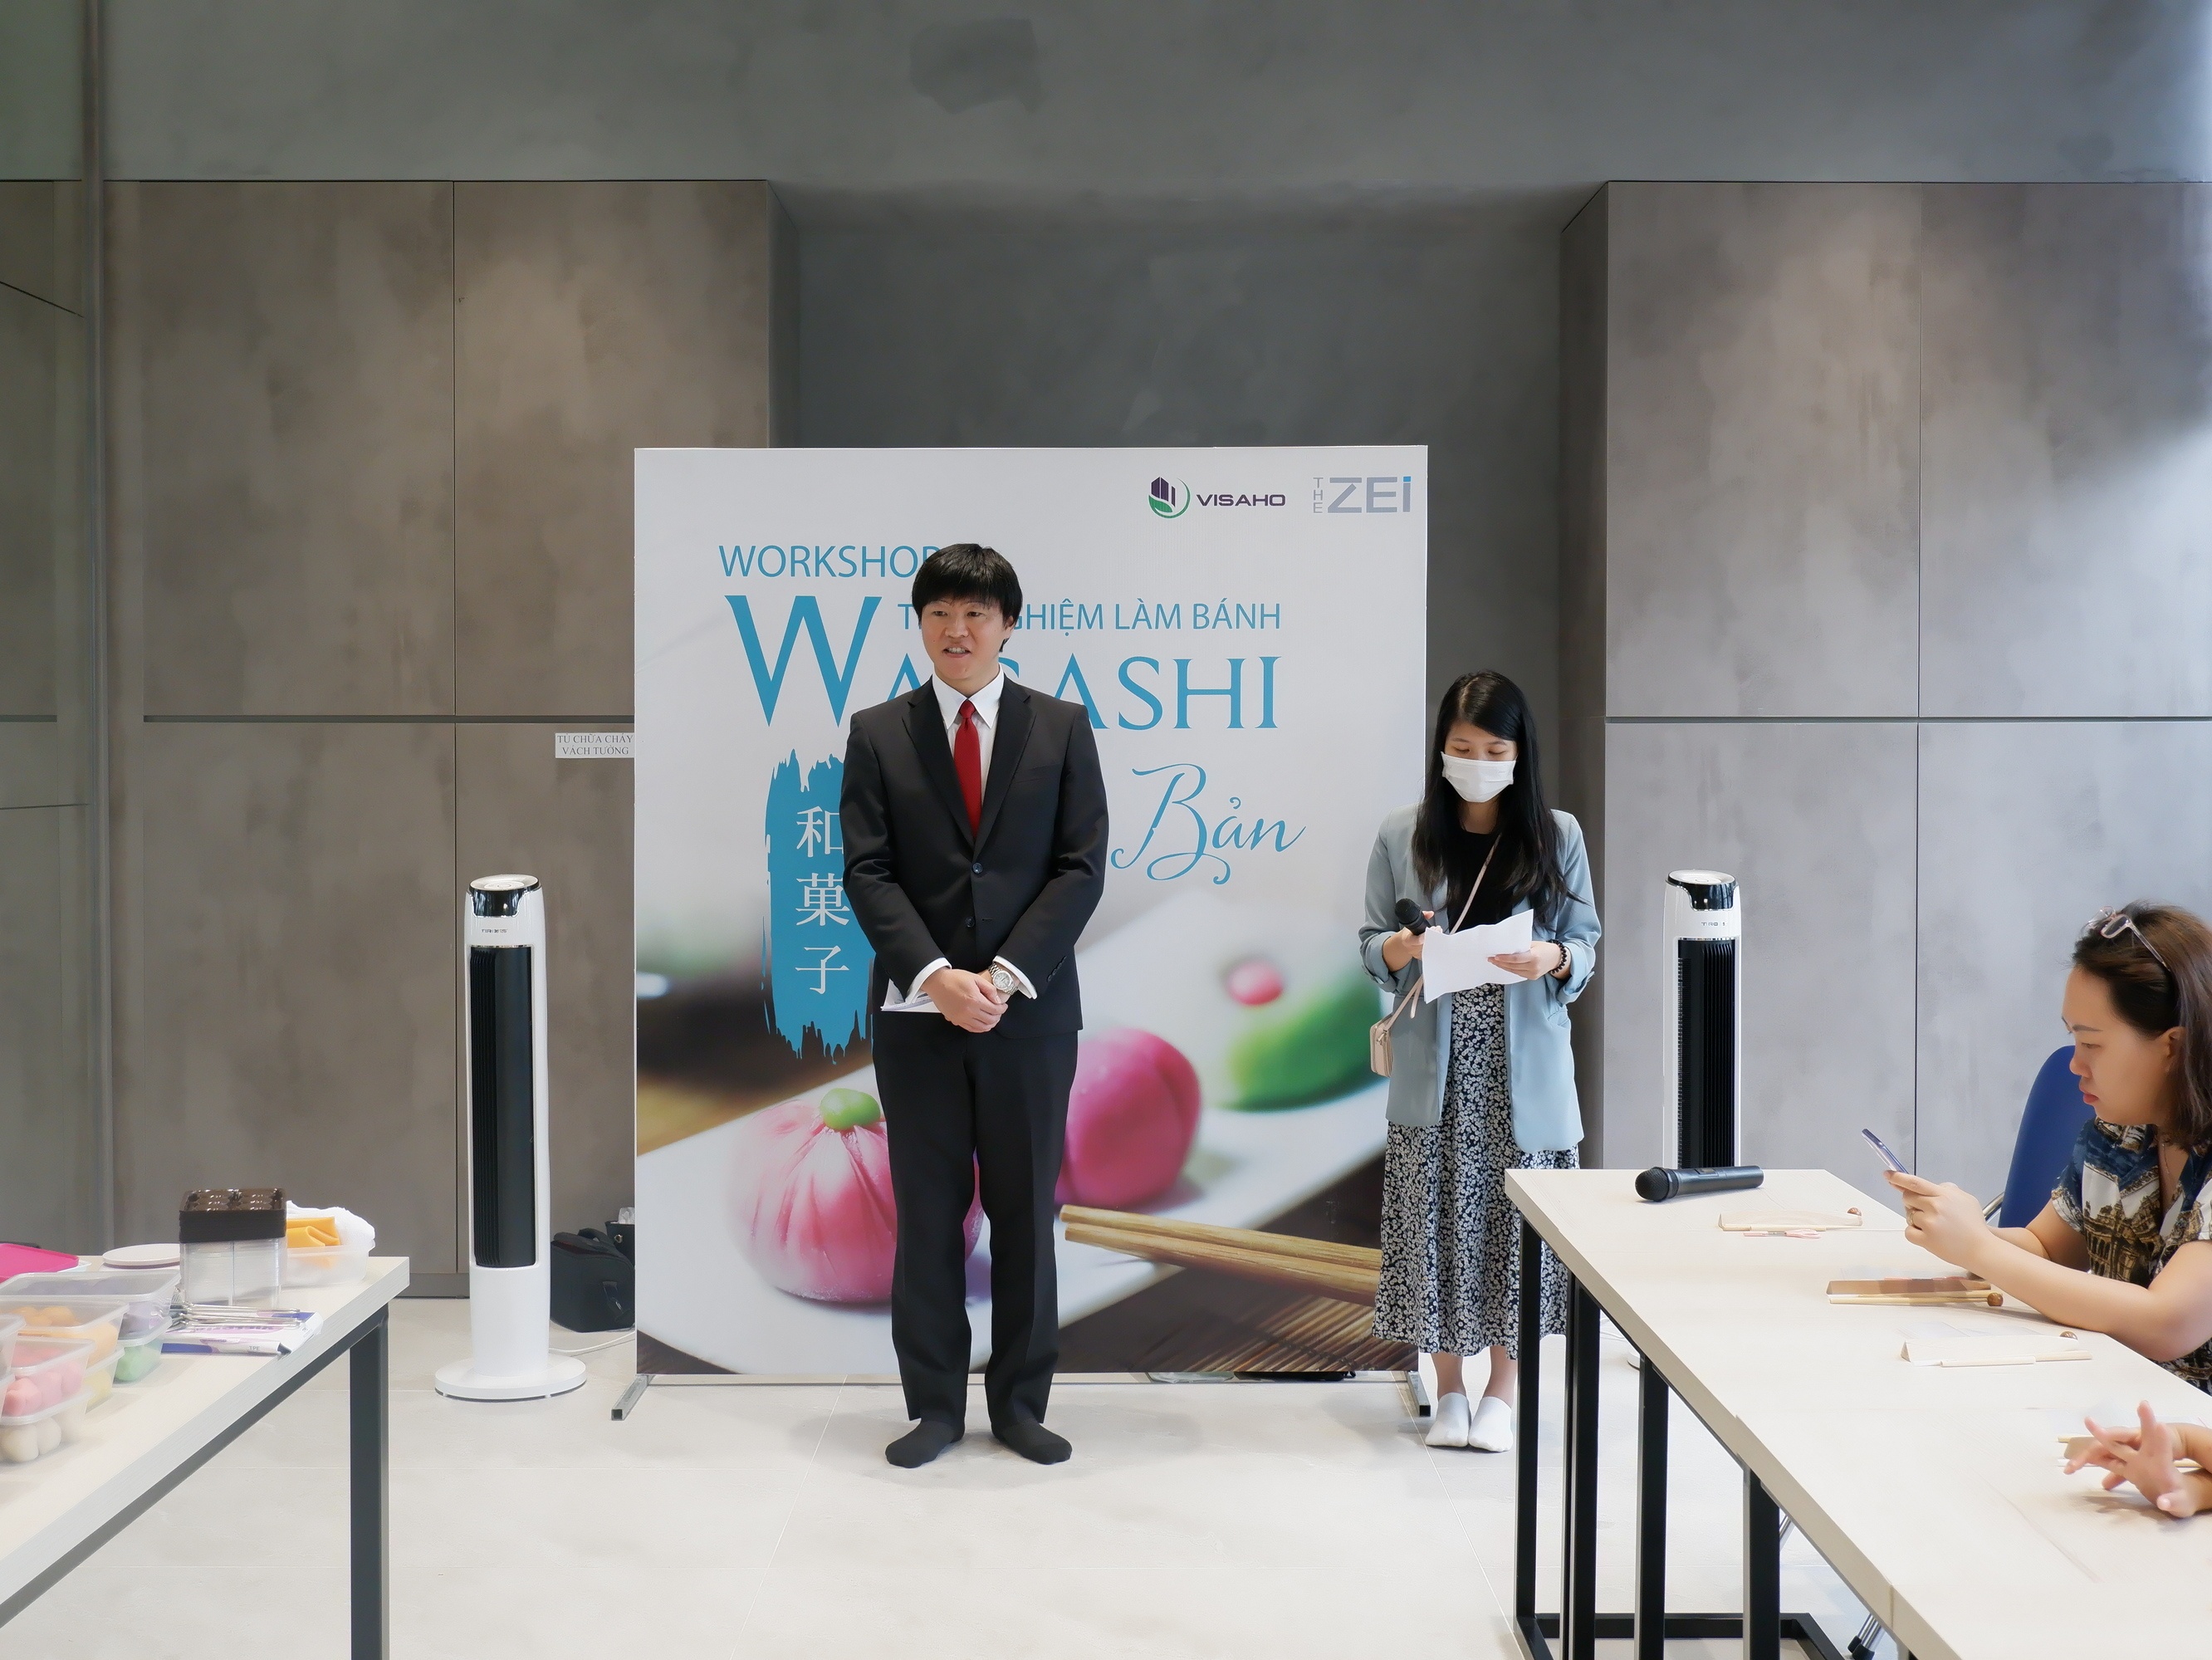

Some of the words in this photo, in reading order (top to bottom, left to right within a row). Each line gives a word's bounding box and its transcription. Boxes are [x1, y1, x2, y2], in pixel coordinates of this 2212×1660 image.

[1197, 494, 1286, 507] VISAHO
[1313, 477, 1324, 513] THE
[1115, 597, 1181, 629] LÀM
[1193, 597, 1280, 629] BÁNH
[724, 595, 1282, 731] WAASHI
[1110, 762, 1307, 885] Bản
[795, 806, 850, 995] 和菓子
